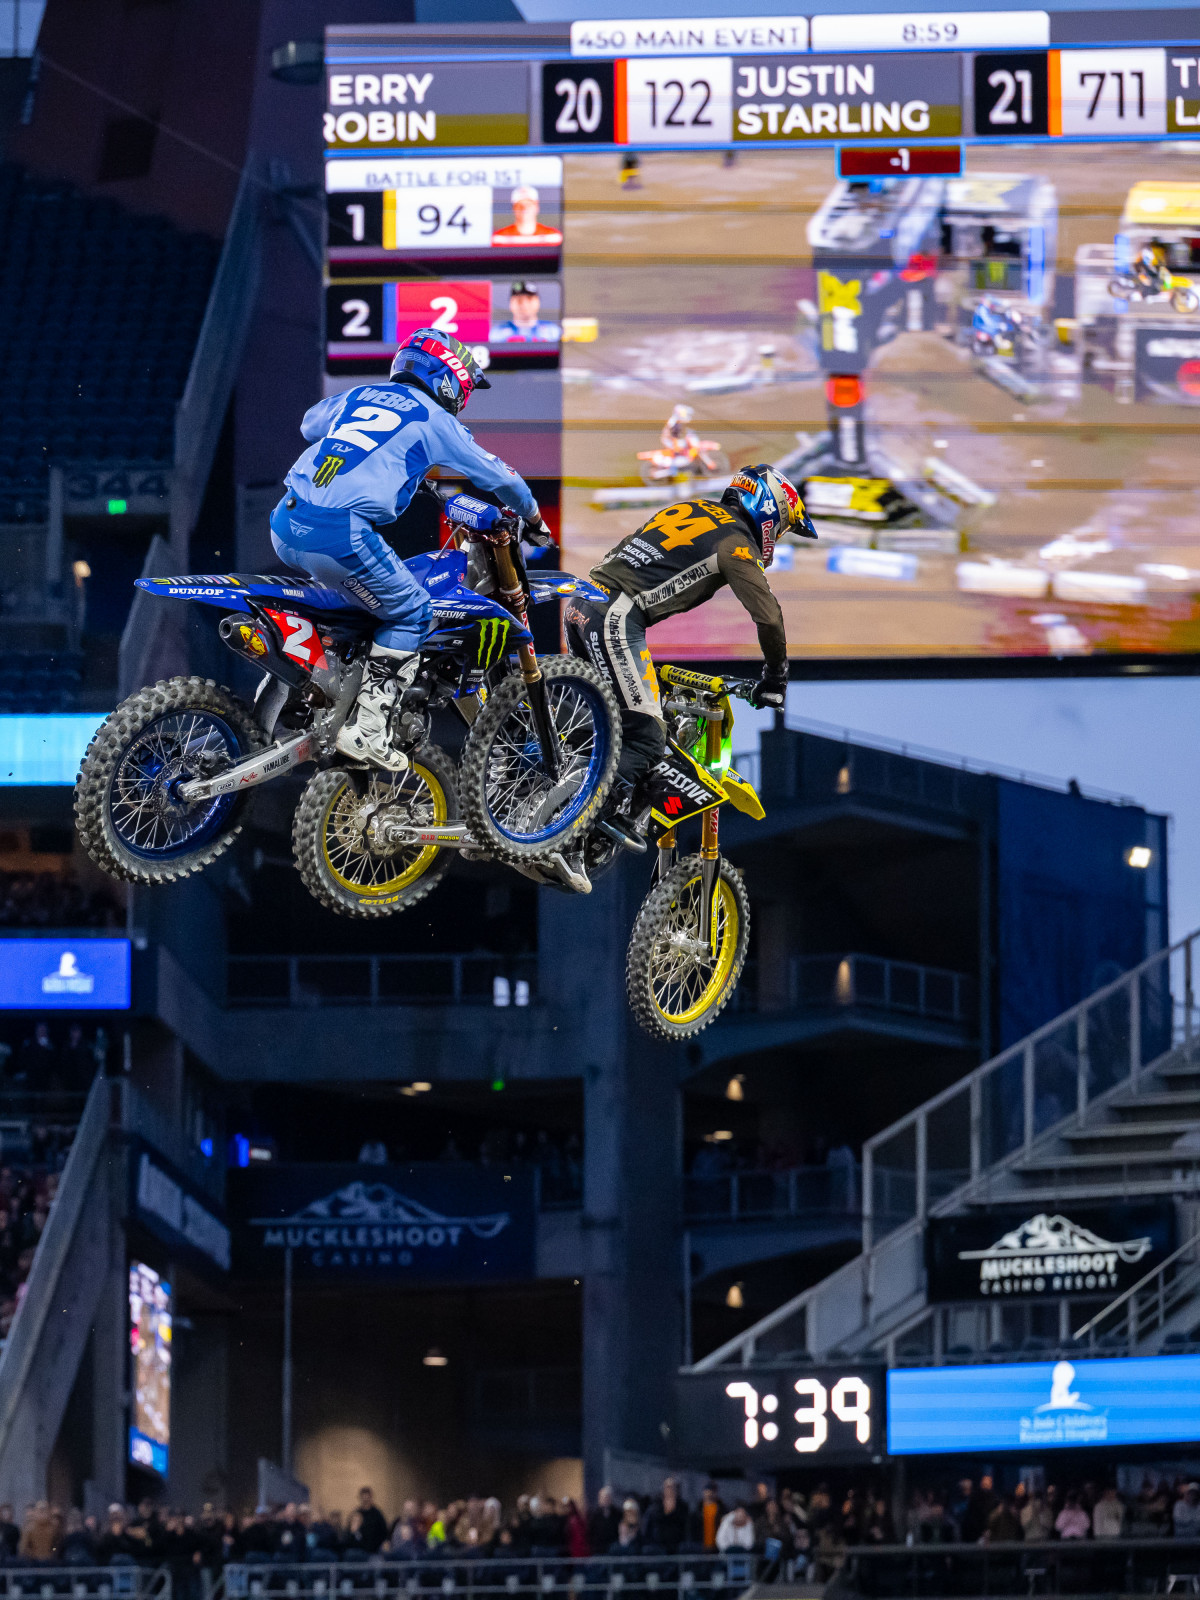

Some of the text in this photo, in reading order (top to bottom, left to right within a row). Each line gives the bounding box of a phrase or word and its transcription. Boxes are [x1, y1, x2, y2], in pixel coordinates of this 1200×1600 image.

[579, 26, 798, 50] 450 MAIN EVENT
[902, 23, 959, 43] 8:59
[329, 73, 434, 106] ERRY
[737, 64, 875, 97] JUSTIN
[1079, 71, 1145, 119] 711
[554, 78, 601, 133] 20
[645, 80, 712, 128] 122
[988, 70, 1033, 124] 21
[1175, 96, 1200, 126] L
[737, 100, 930, 136] STARLING
[890, 148, 910, 171] -1
[366, 169, 522, 187] BATTLE FOR 1ST
[347, 205, 365, 241] 1
[418, 204, 472, 236] 94
[341, 300, 371, 337] 2
[430, 297, 459, 333] 2
[356, 387, 420, 413] WEBB
[327, 406, 402, 452] 2
[331, 442, 353, 453] FLY
[641, 503, 719, 552] 94
[622, 544, 652, 566] SUZUKI
[169, 588, 224, 596] DUNLOP
[282, 588, 305, 598] YAMAHA
[353, 583, 382, 611] YAMAHA
[281, 616, 313, 661] 2
[262, 754, 290, 774] YAMALUBE
[359, 895, 400, 906] DUNLOP
[263, 1225, 463, 1249] MUCKLESHOOT
[311, 1252, 414, 1267] CASINO
[980, 1252, 1119, 1280] MUCKLESHOOT
[980, 1273, 1119, 1295] CASINO RESORT
[725, 1376, 871, 1453] 7:39
